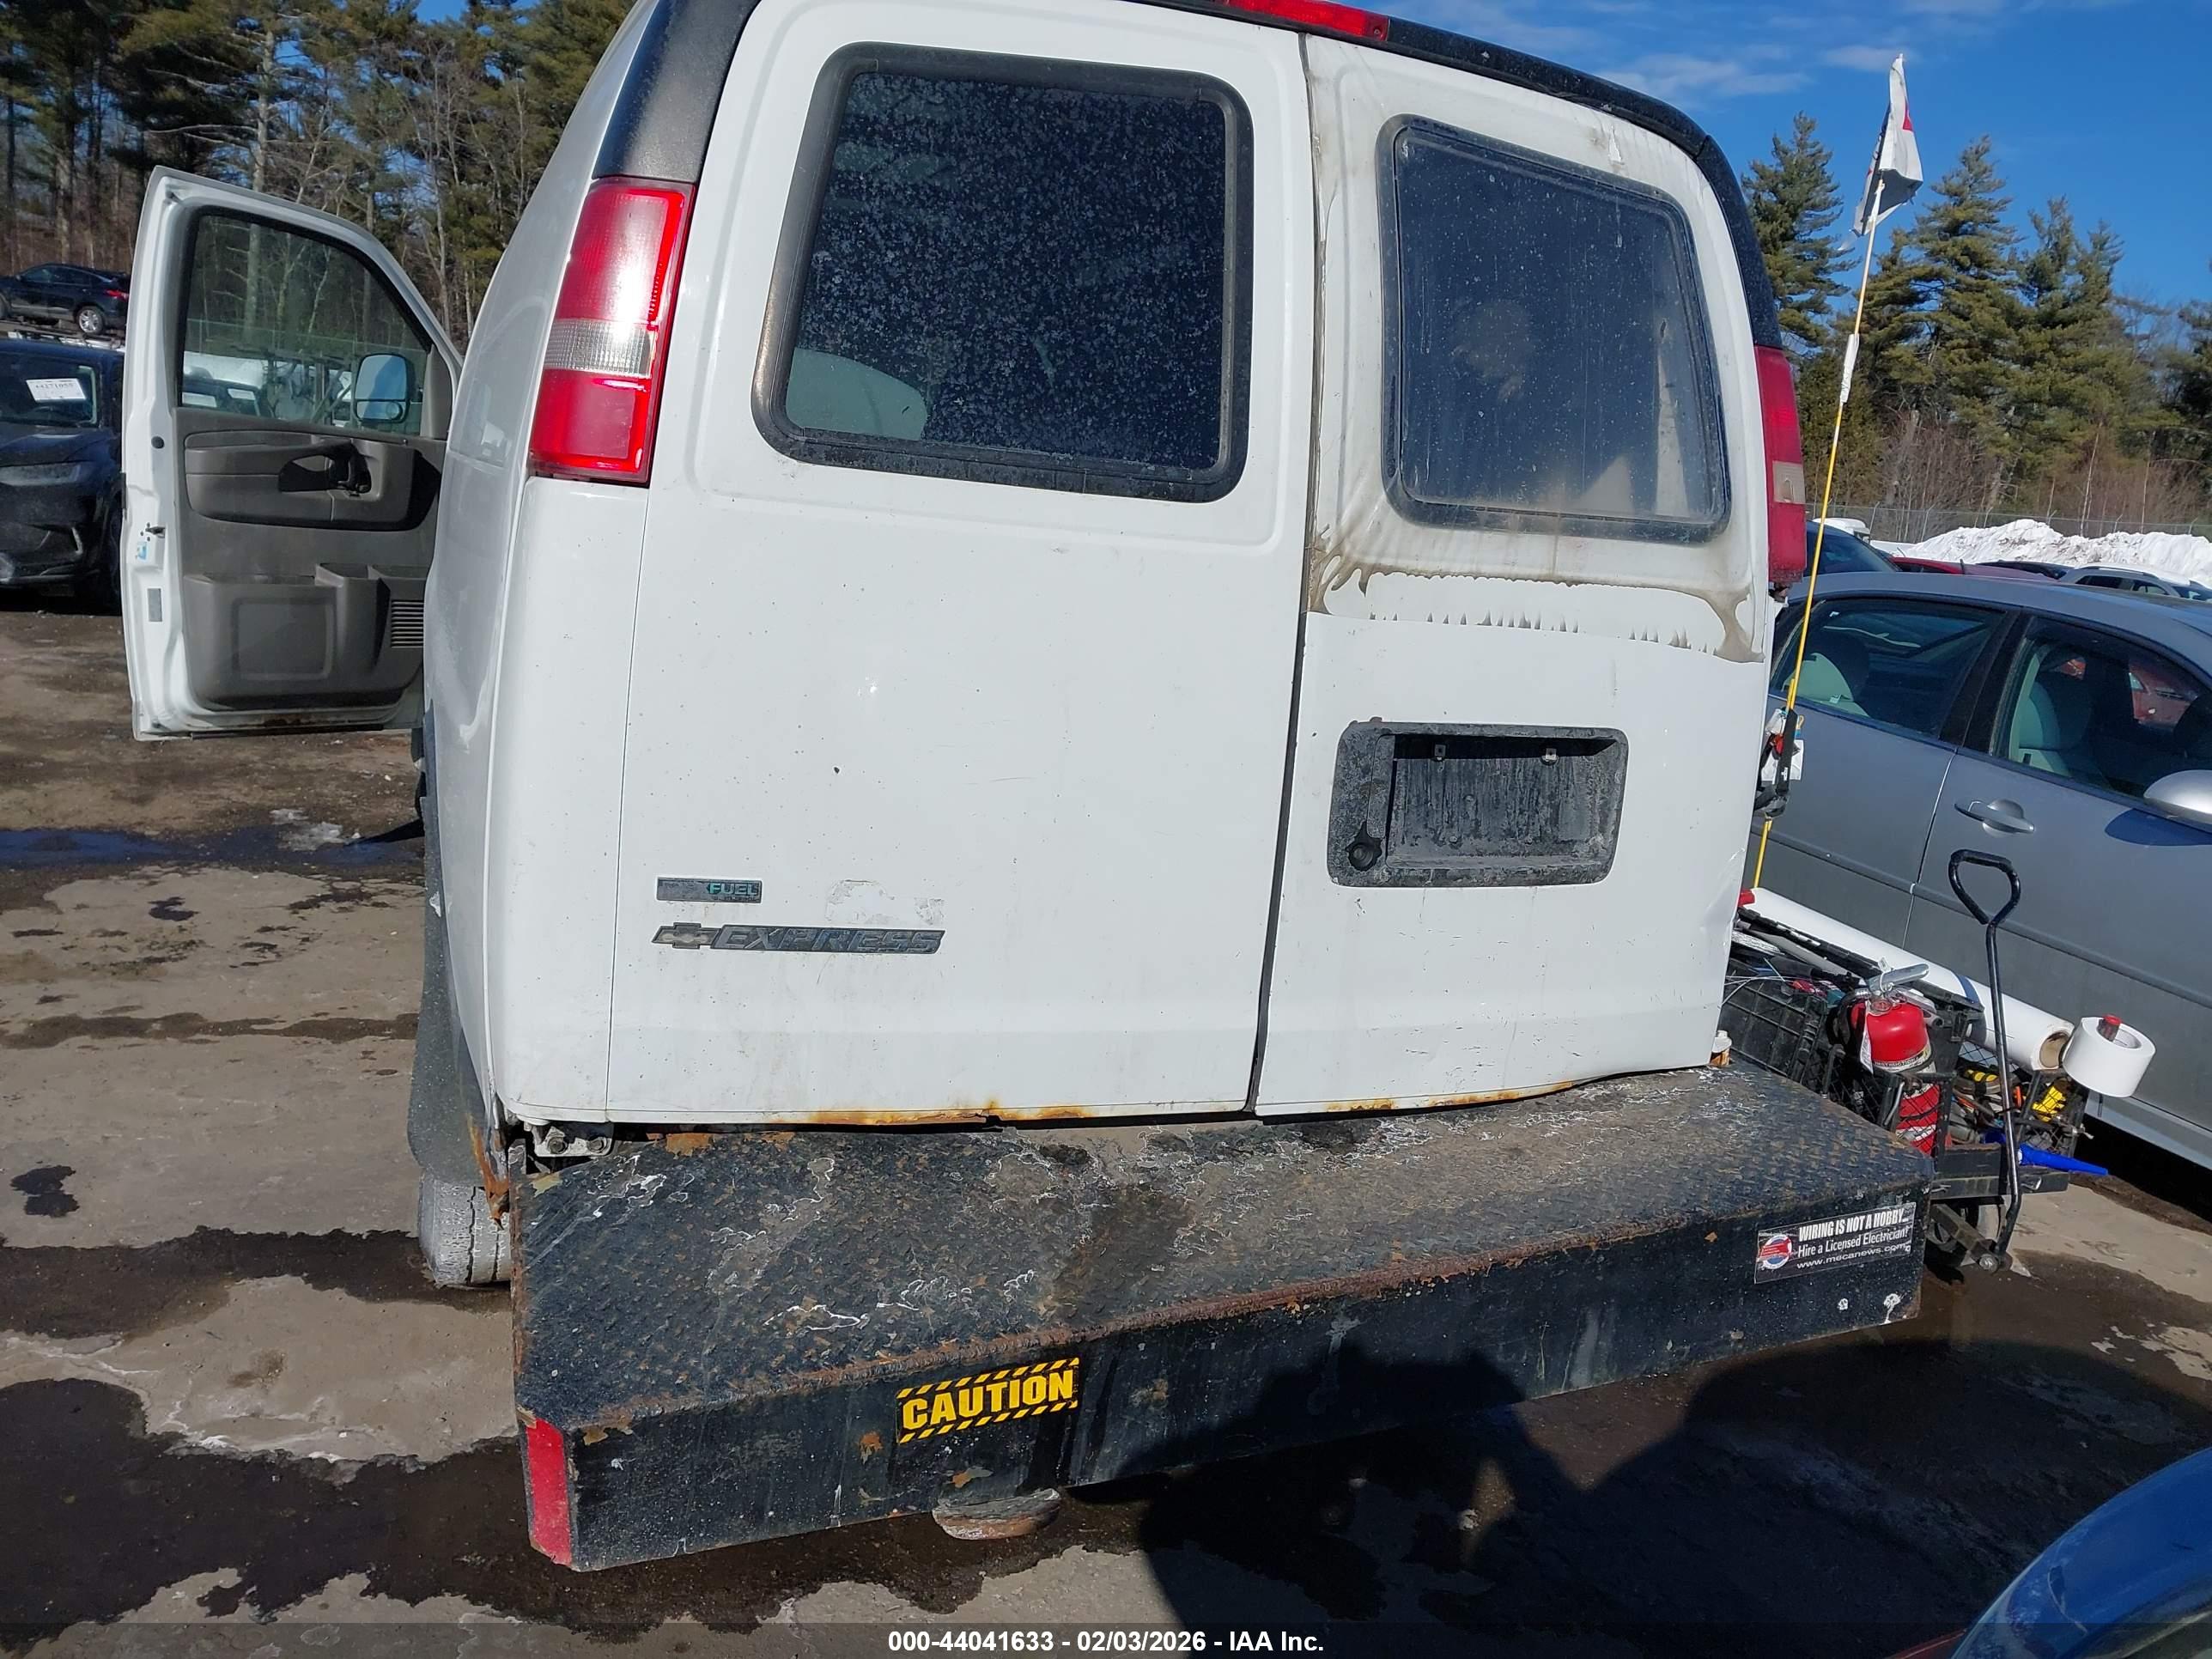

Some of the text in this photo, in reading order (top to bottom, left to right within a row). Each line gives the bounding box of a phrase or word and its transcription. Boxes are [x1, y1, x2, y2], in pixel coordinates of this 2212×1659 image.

[717, 926, 943, 953] EXPRESS
[1798, 1220, 1835, 1243] WIRING
[1835, 1218, 1846, 1236] IS
[1846, 1214, 1866, 1233] NOT
[1865, 1213, 1873, 1230] A
[1797, 1243, 1816, 1258] Hire
[1817, 1244, 1823, 1255] a
[1825, 1234, 1862, 1253] Licensed
[902, 1369, 1074, 1431] CAUTION
